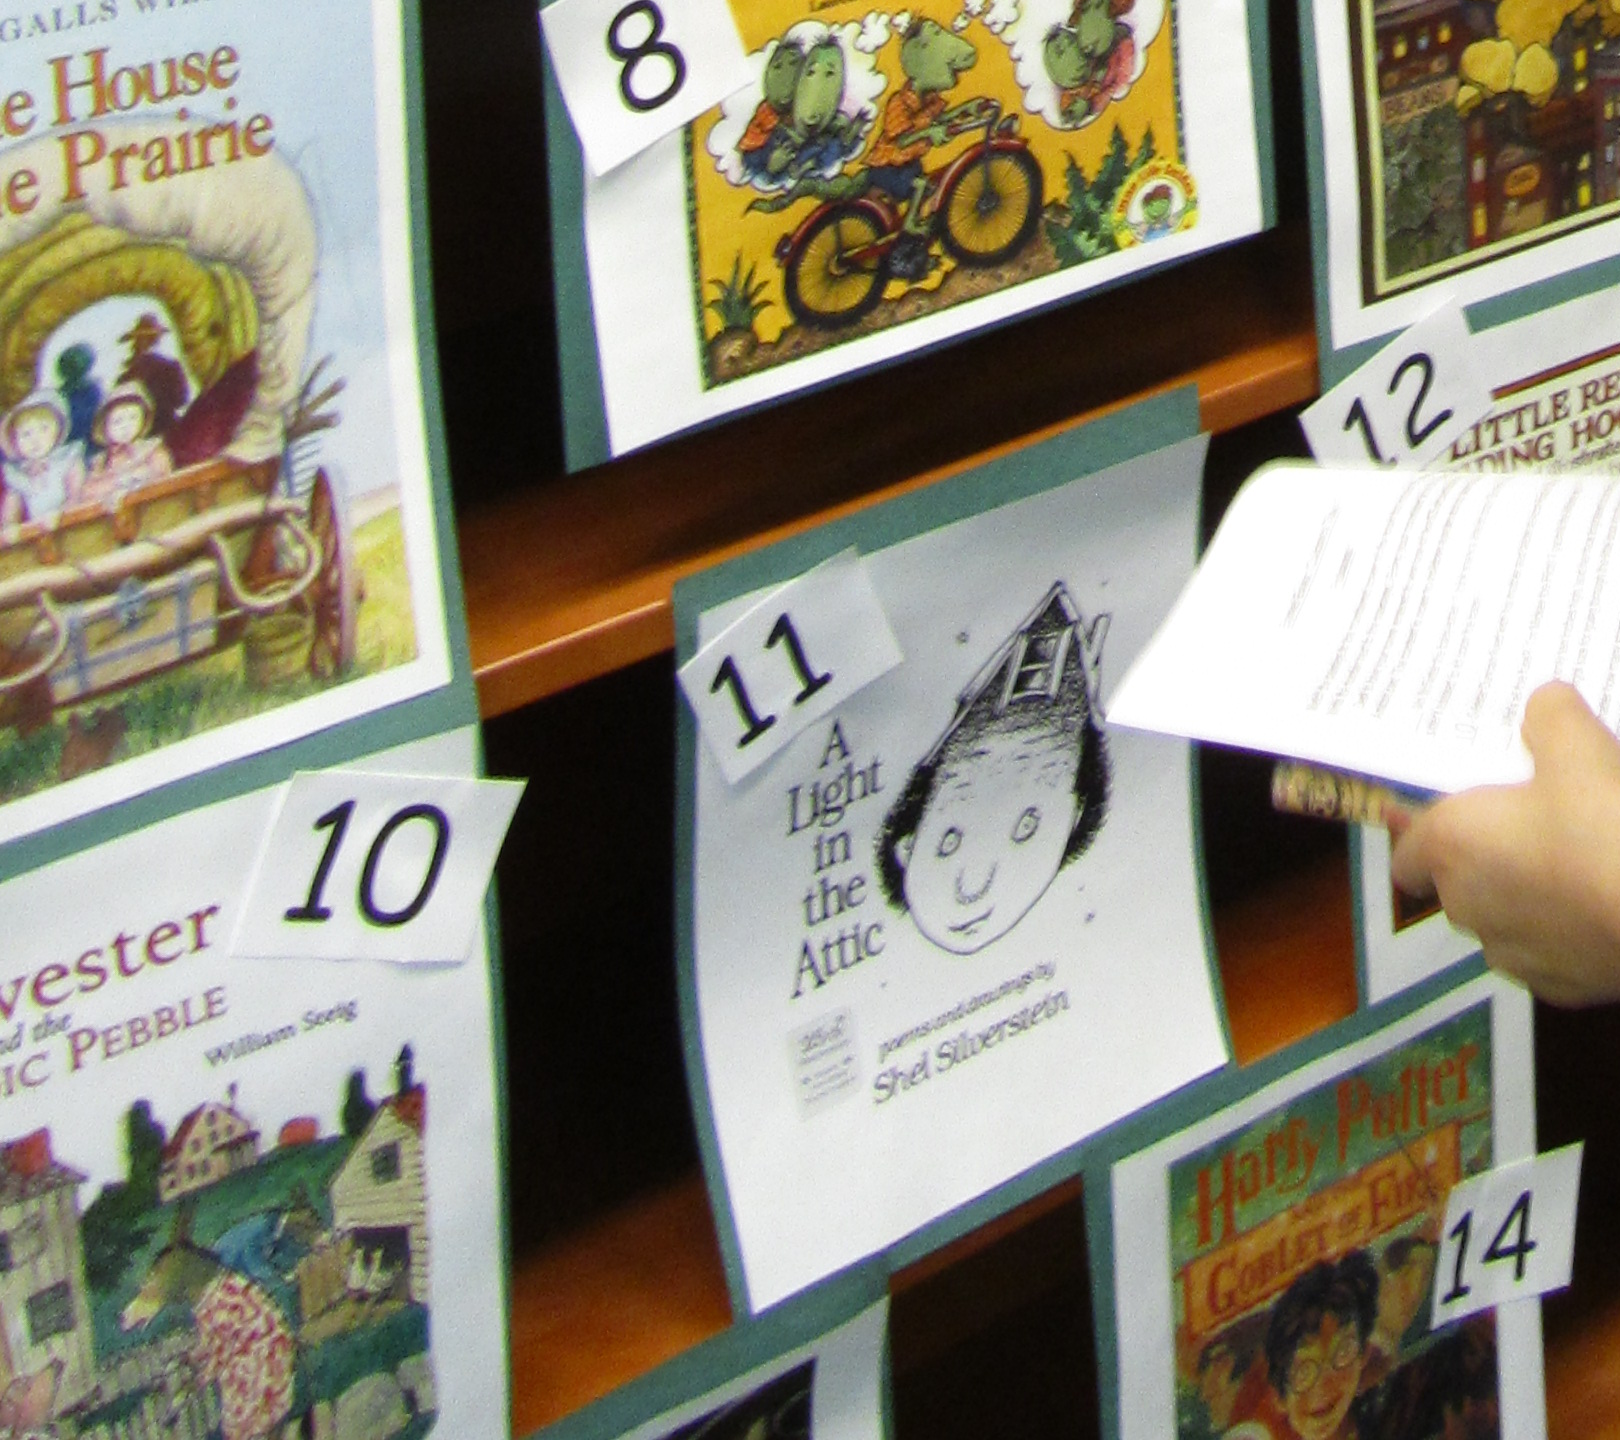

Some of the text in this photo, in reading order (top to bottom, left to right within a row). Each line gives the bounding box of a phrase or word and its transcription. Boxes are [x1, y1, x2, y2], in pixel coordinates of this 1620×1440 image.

[48, 43, 241, 128] House
[606, 0, 686, 114] 8
[58, 96, 277, 204] Prairie
[1342, 352, 1454, 468] 12
[1452, 389, 1571, 459] LITTLE
[709, 612, 833, 748] 11
[818, 720, 850, 769] A
[786, 757, 884, 836] Light
[283, 800, 451, 929] 10
[811, 832, 852, 874] in
[803, 875, 868, 929] the
[0, 903, 221, 1015] vester
[790, 919, 887, 1001] Attic
[32, 1012, 73, 1043] the
[66, 984, 230, 1073] PEBBLE
[204, 999, 360, 1068] William Steig
[873, 1048, 931, 1104] Shel
[935, 989, 1071, 1073] Silverstein
[1192, 1043, 1481, 1250] Harry Potter
[1439, 1187, 1538, 1307] 14
